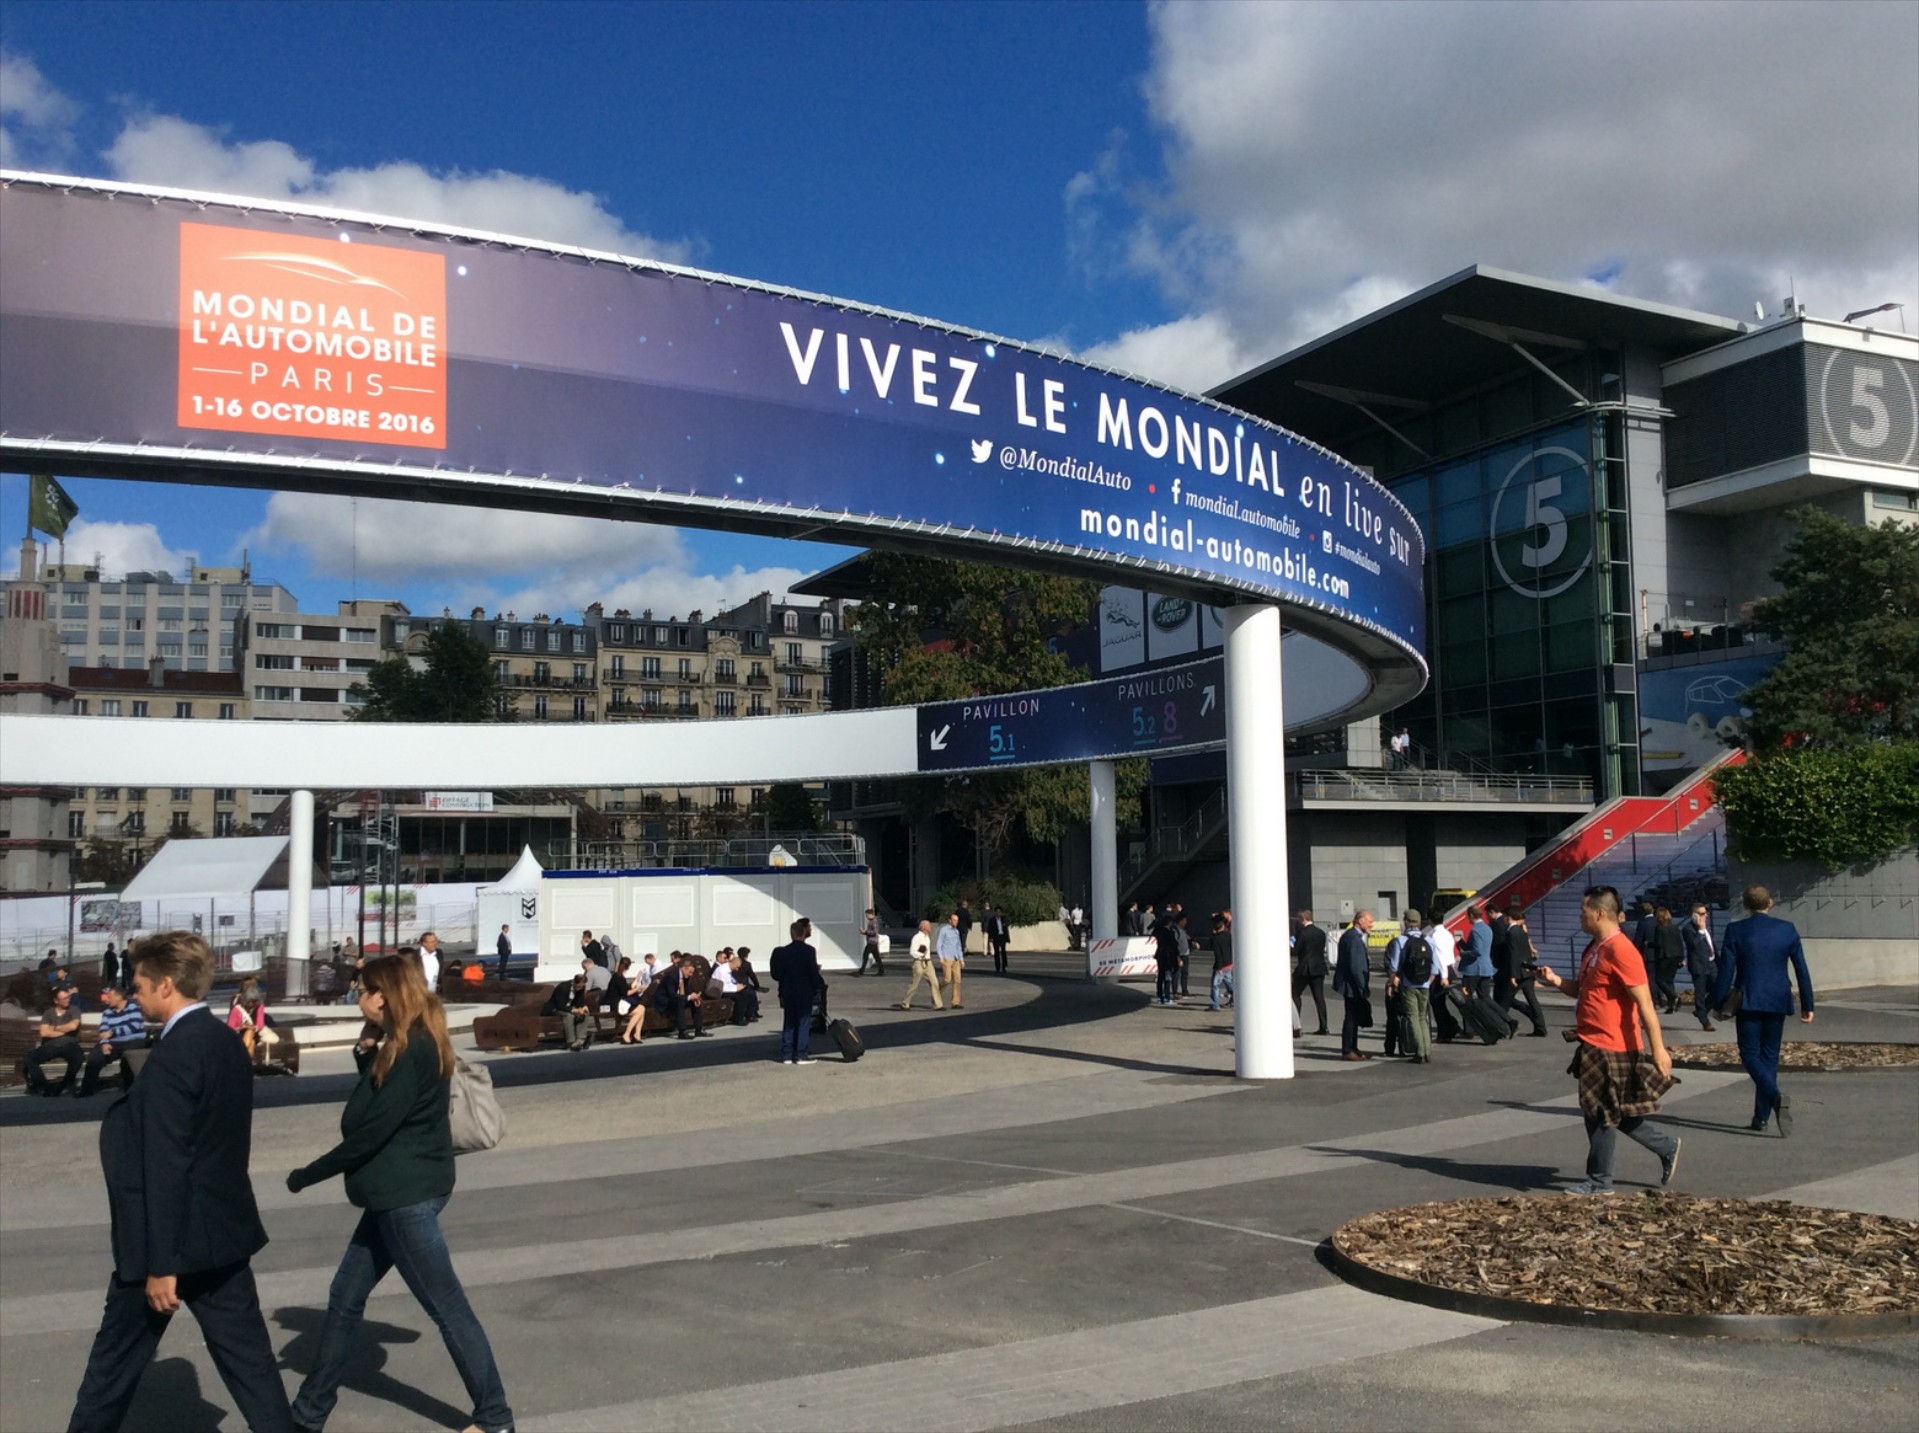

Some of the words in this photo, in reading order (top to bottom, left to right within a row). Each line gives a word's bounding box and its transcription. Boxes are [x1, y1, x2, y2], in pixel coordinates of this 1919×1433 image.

[193, 290, 375, 332] MONDIAL
[393, 311, 436, 339] DE
[192, 319, 436, 368] L'AUTOMOBILE
[250, 362, 384, 397] PARIS
[192, 395, 243, 417] 1-16
[251, 400, 370, 428] OCTOBRE
[378, 411, 435, 435] 2016
[1849, 366, 1890, 448] 5
[779, 321, 981, 416] VIVEZ
[1015, 371, 1067, 434] LE
[1097, 391, 1285, 498] MONDIAL
[1301, 475, 1332, 518] en
[1345, 480, 1384, 546] live
[1389, 526, 1411, 567] sur
[1000, 446, 1132, 492] @MondialAuto
[1185, 490, 1301, 540] mondial.automobile
[1522, 475, 1568, 568] 5
[1080, 508, 1350, 600] mondial-automobile.com
[1161, 608, 1187, 624] ROVER
[1103, 630, 1142, 648] JAGUAR
[1117, 672, 1195, 701] PAVILLONS
[963, 698, 1040, 721] PAVILLON
[1163, 701, 1178, 734] 8
[989, 725, 1016, 753] 5.1
